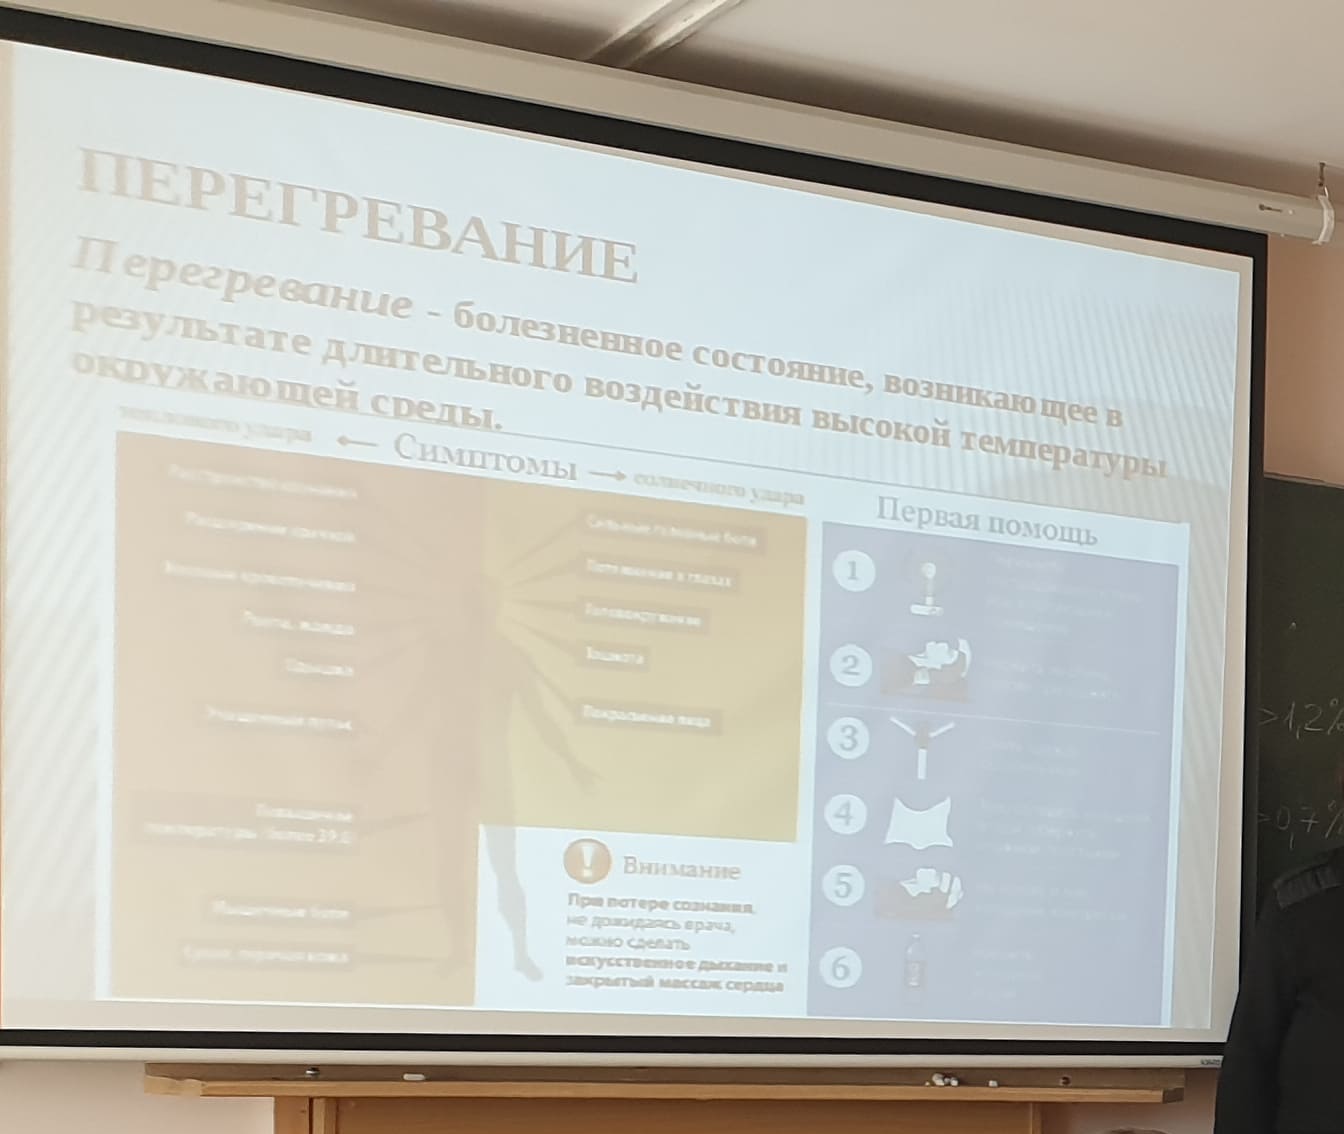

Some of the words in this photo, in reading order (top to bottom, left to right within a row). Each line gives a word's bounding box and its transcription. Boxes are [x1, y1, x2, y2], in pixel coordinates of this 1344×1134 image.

[78, 147, 640, 284] ПЕРЕГРЕВАНИЕ
[71, 236, 412, 320] Перегревание
[453, 300, 683, 363] болезненное
[692, 343, 874, 394] состояние,
[883, 373, 1098, 426] возникающее
[1106, 405, 1123, 428] в
[72, 348, 359, 414] окружающей
[371, 393, 503, 433] среды.
[73, 299, 312, 355] результате
[322, 338, 573, 395] длительного
[584, 374, 801, 427] воздействия
[812, 408, 951, 449] высокой
[960, 430, 1167, 480] температуры
[394, 432, 578, 482] Симптомы
[876, 495, 991, 536] Первая
[994, 515, 1099, 549] помощь
[847, 560, 859, 581] 1
[843, 655, 859, 677] 2
[840, 726, 858, 751] 3
[834, 800, 854, 826] 4
[623, 855, 741, 880] Внимание
[834, 873, 853, 898] 5
[607, 897, 669, 912] потере
[831, 956, 850, 981] 6
